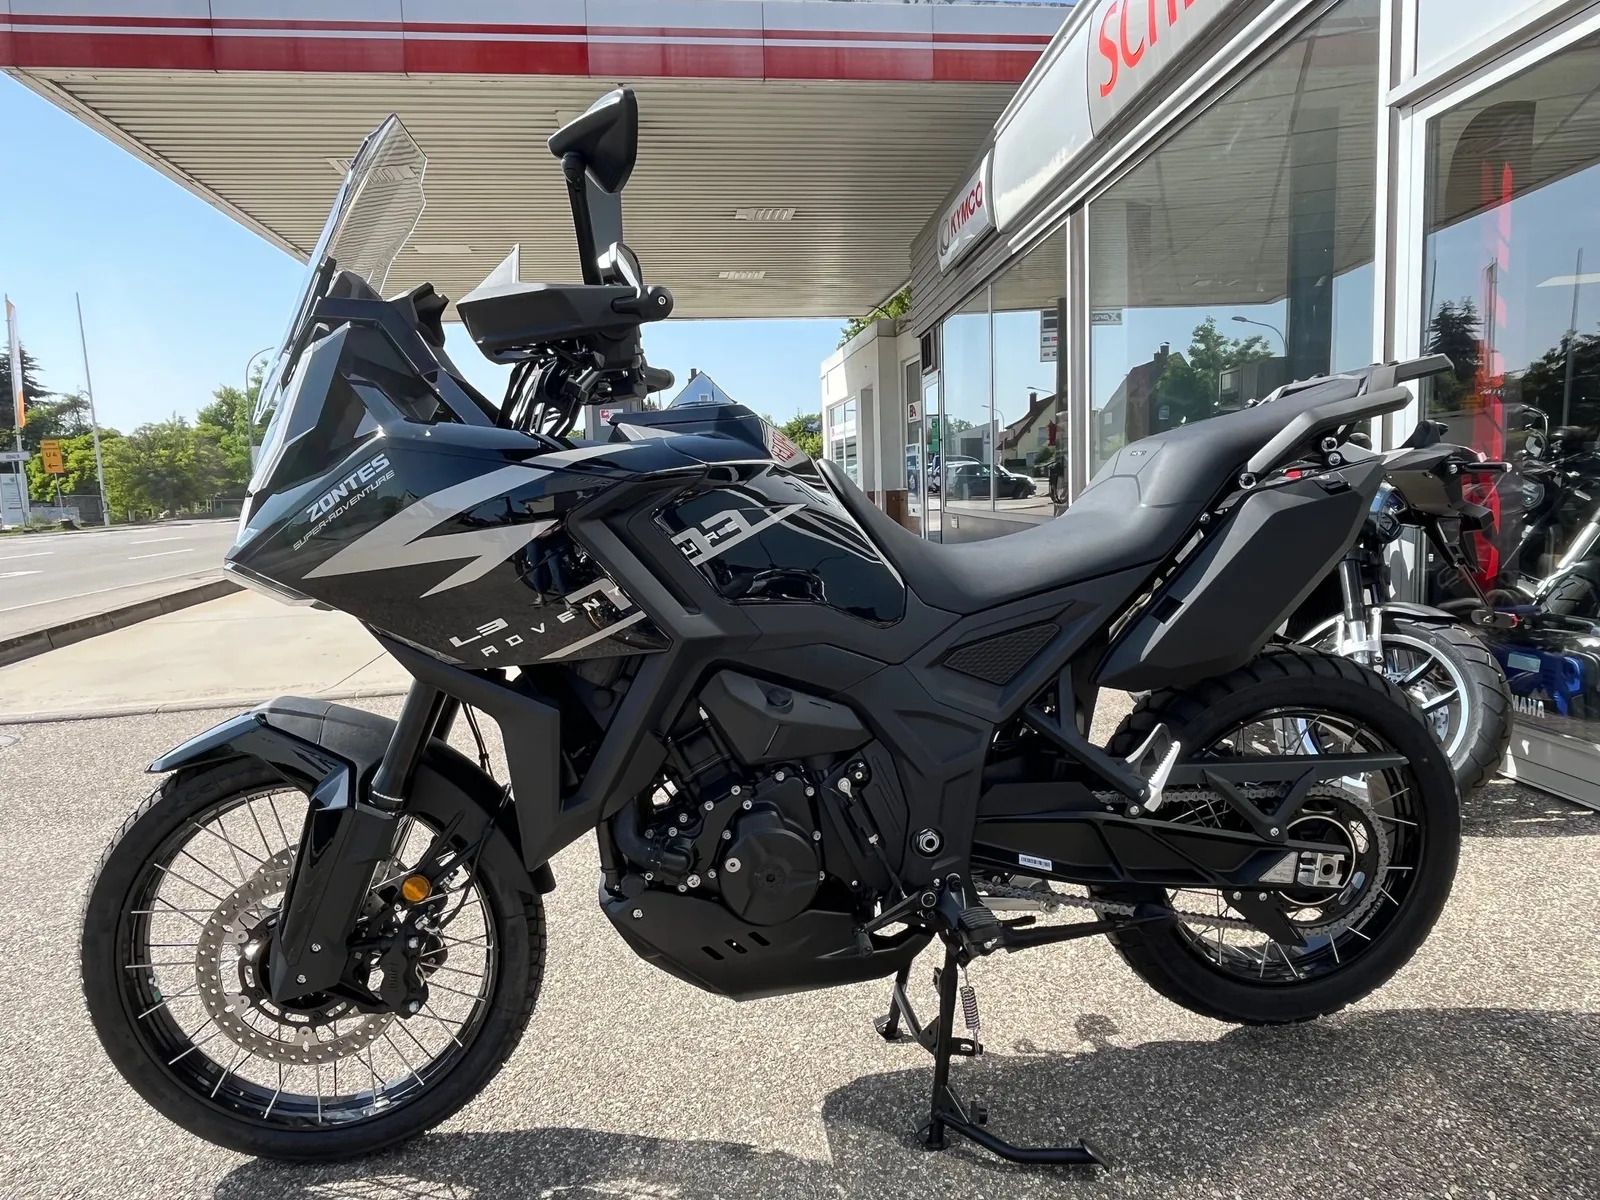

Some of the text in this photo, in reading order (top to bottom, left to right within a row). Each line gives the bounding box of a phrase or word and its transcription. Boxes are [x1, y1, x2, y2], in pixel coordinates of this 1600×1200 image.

[950, 180, 983, 237] KYMCO
[293, 469, 395, 551] SUPER-ADVENTURE
[306, 453, 390, 523] ZONTES
